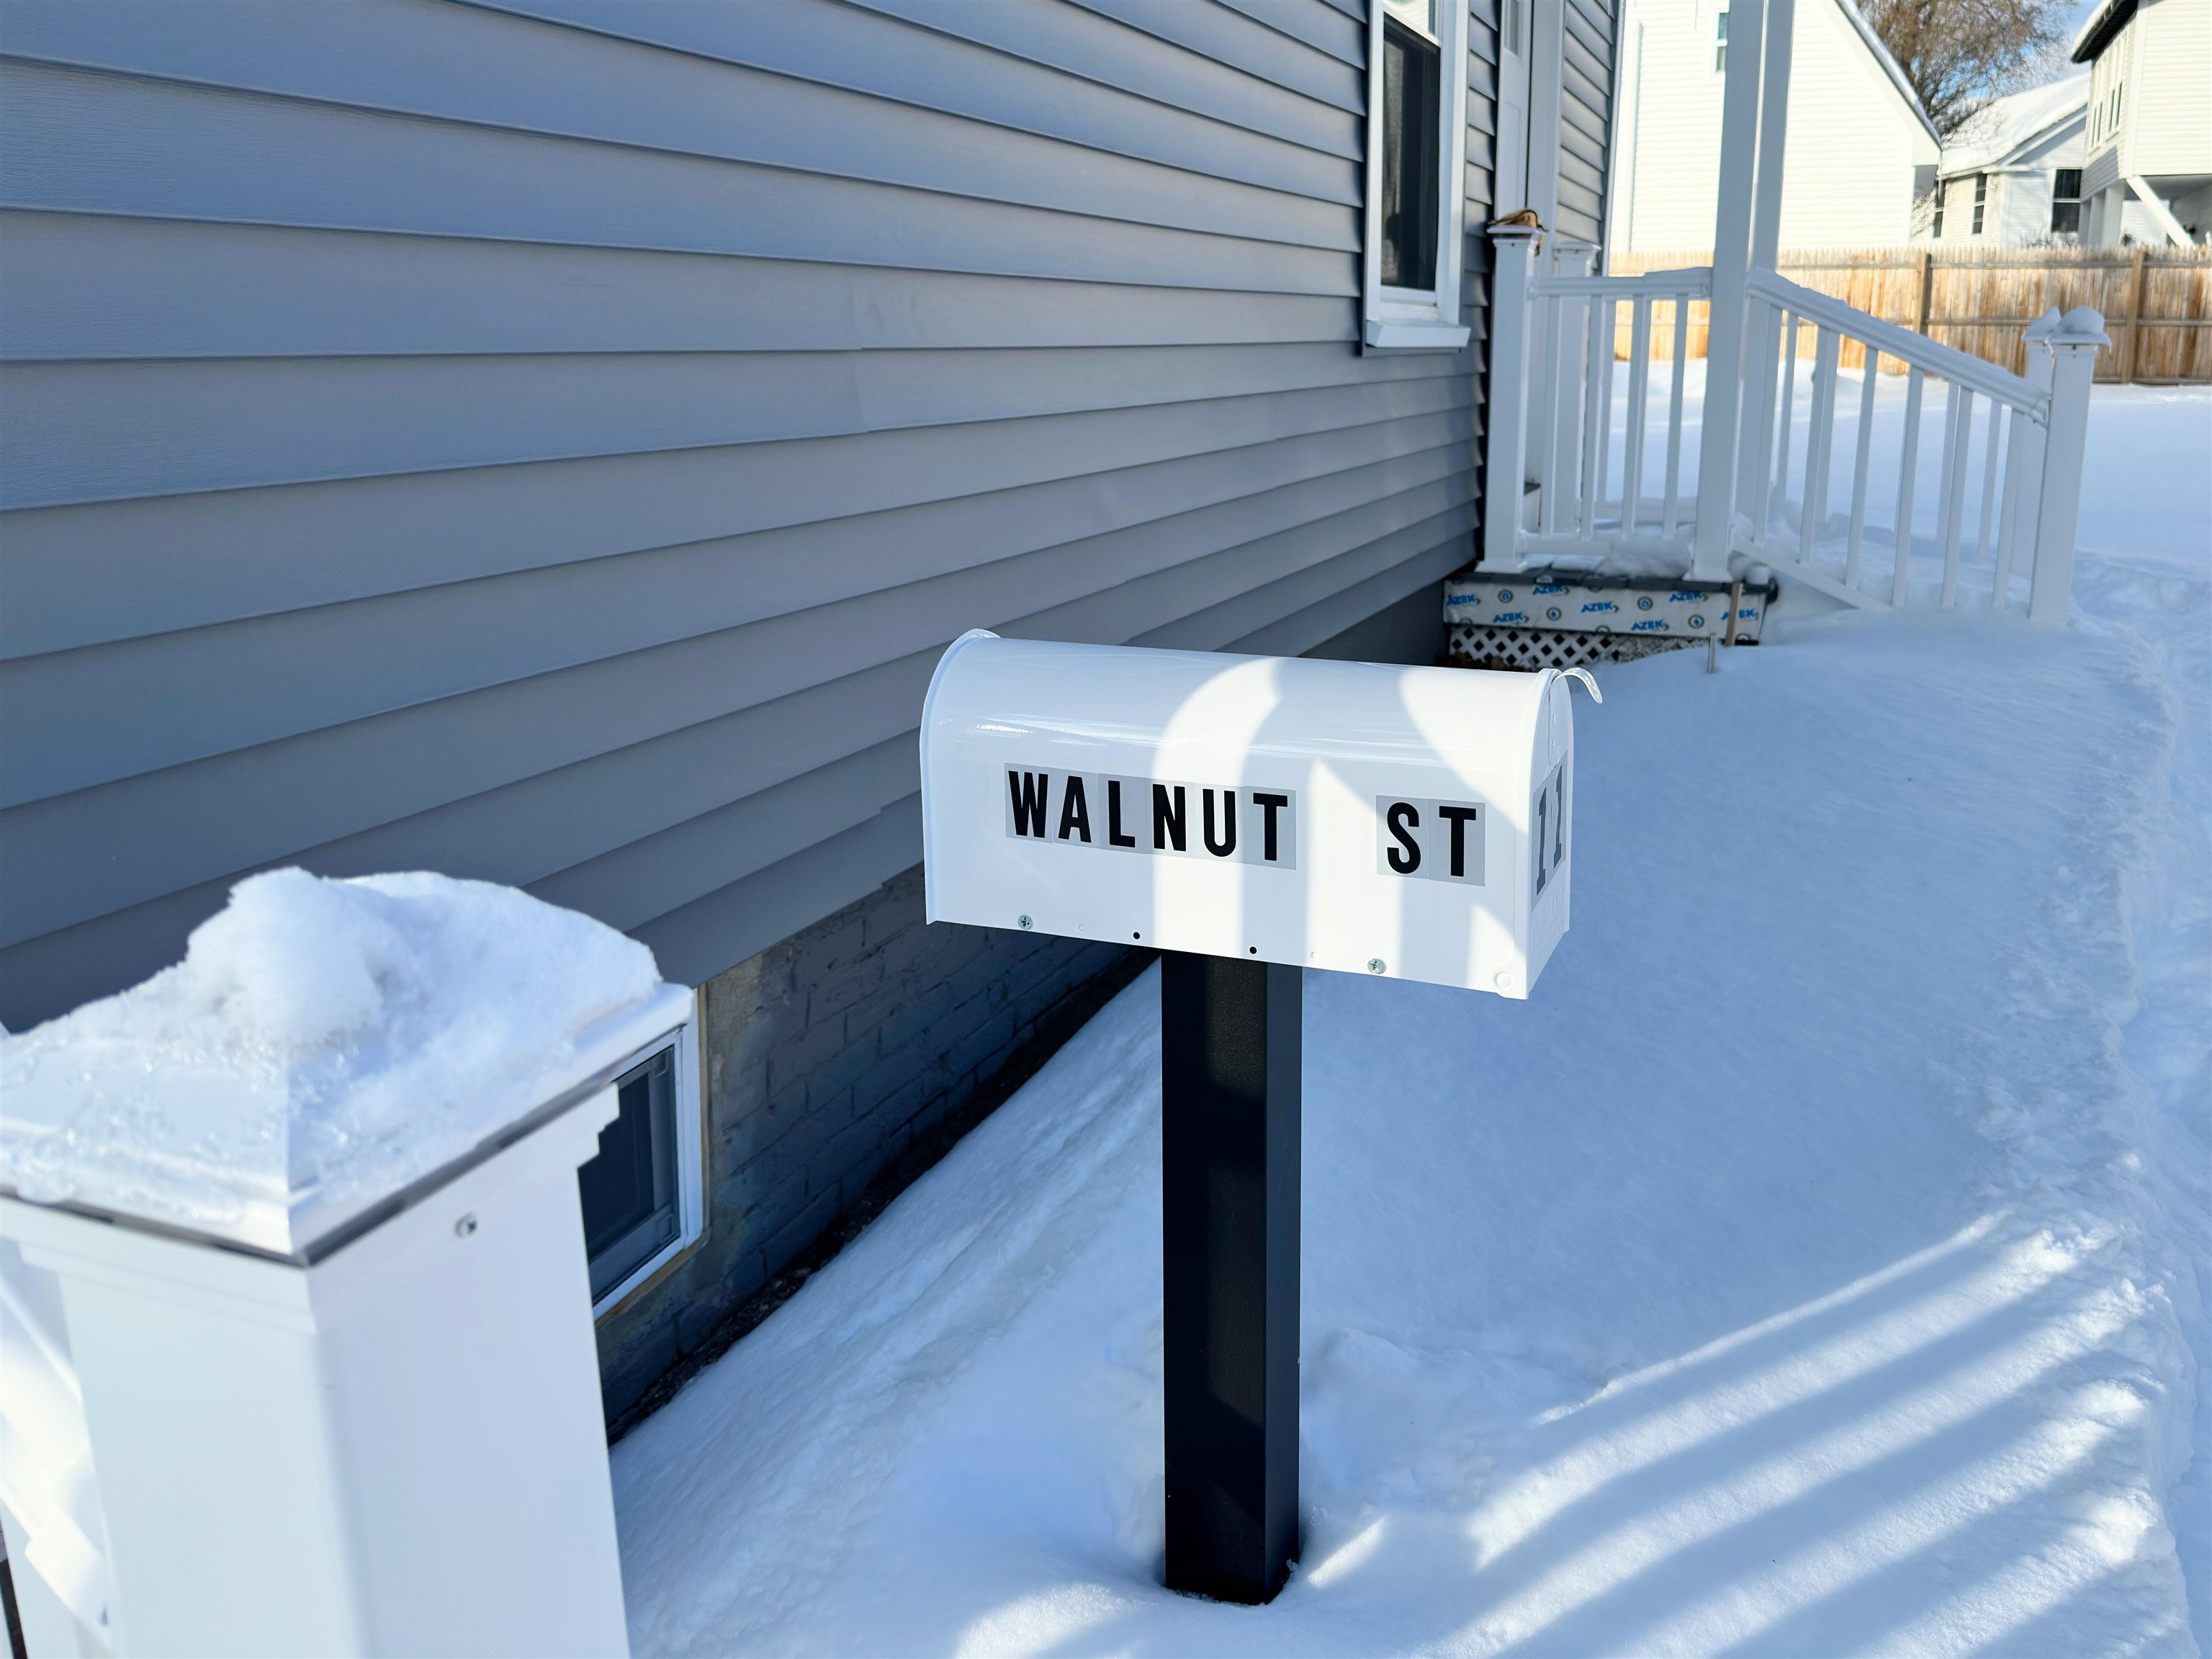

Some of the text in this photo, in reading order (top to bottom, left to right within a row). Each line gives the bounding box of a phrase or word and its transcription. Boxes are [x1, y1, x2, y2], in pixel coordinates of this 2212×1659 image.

[1532, 584, 1564, 595] AZEK
[1446, 594, 1476, 606] AZEK
[1669, 591, 1702, 603] AZEK
[1581, 601, 1613, 613] AZEK
[1493, 611, 1524, 623] AZEK
[1721, 608, 1755, 621] AEK
[1631, 619, 1664, 631] AZEK
[1008, 770, 1477, 878] WALNUT ST
[1536, 764, 1563, 896] 11
